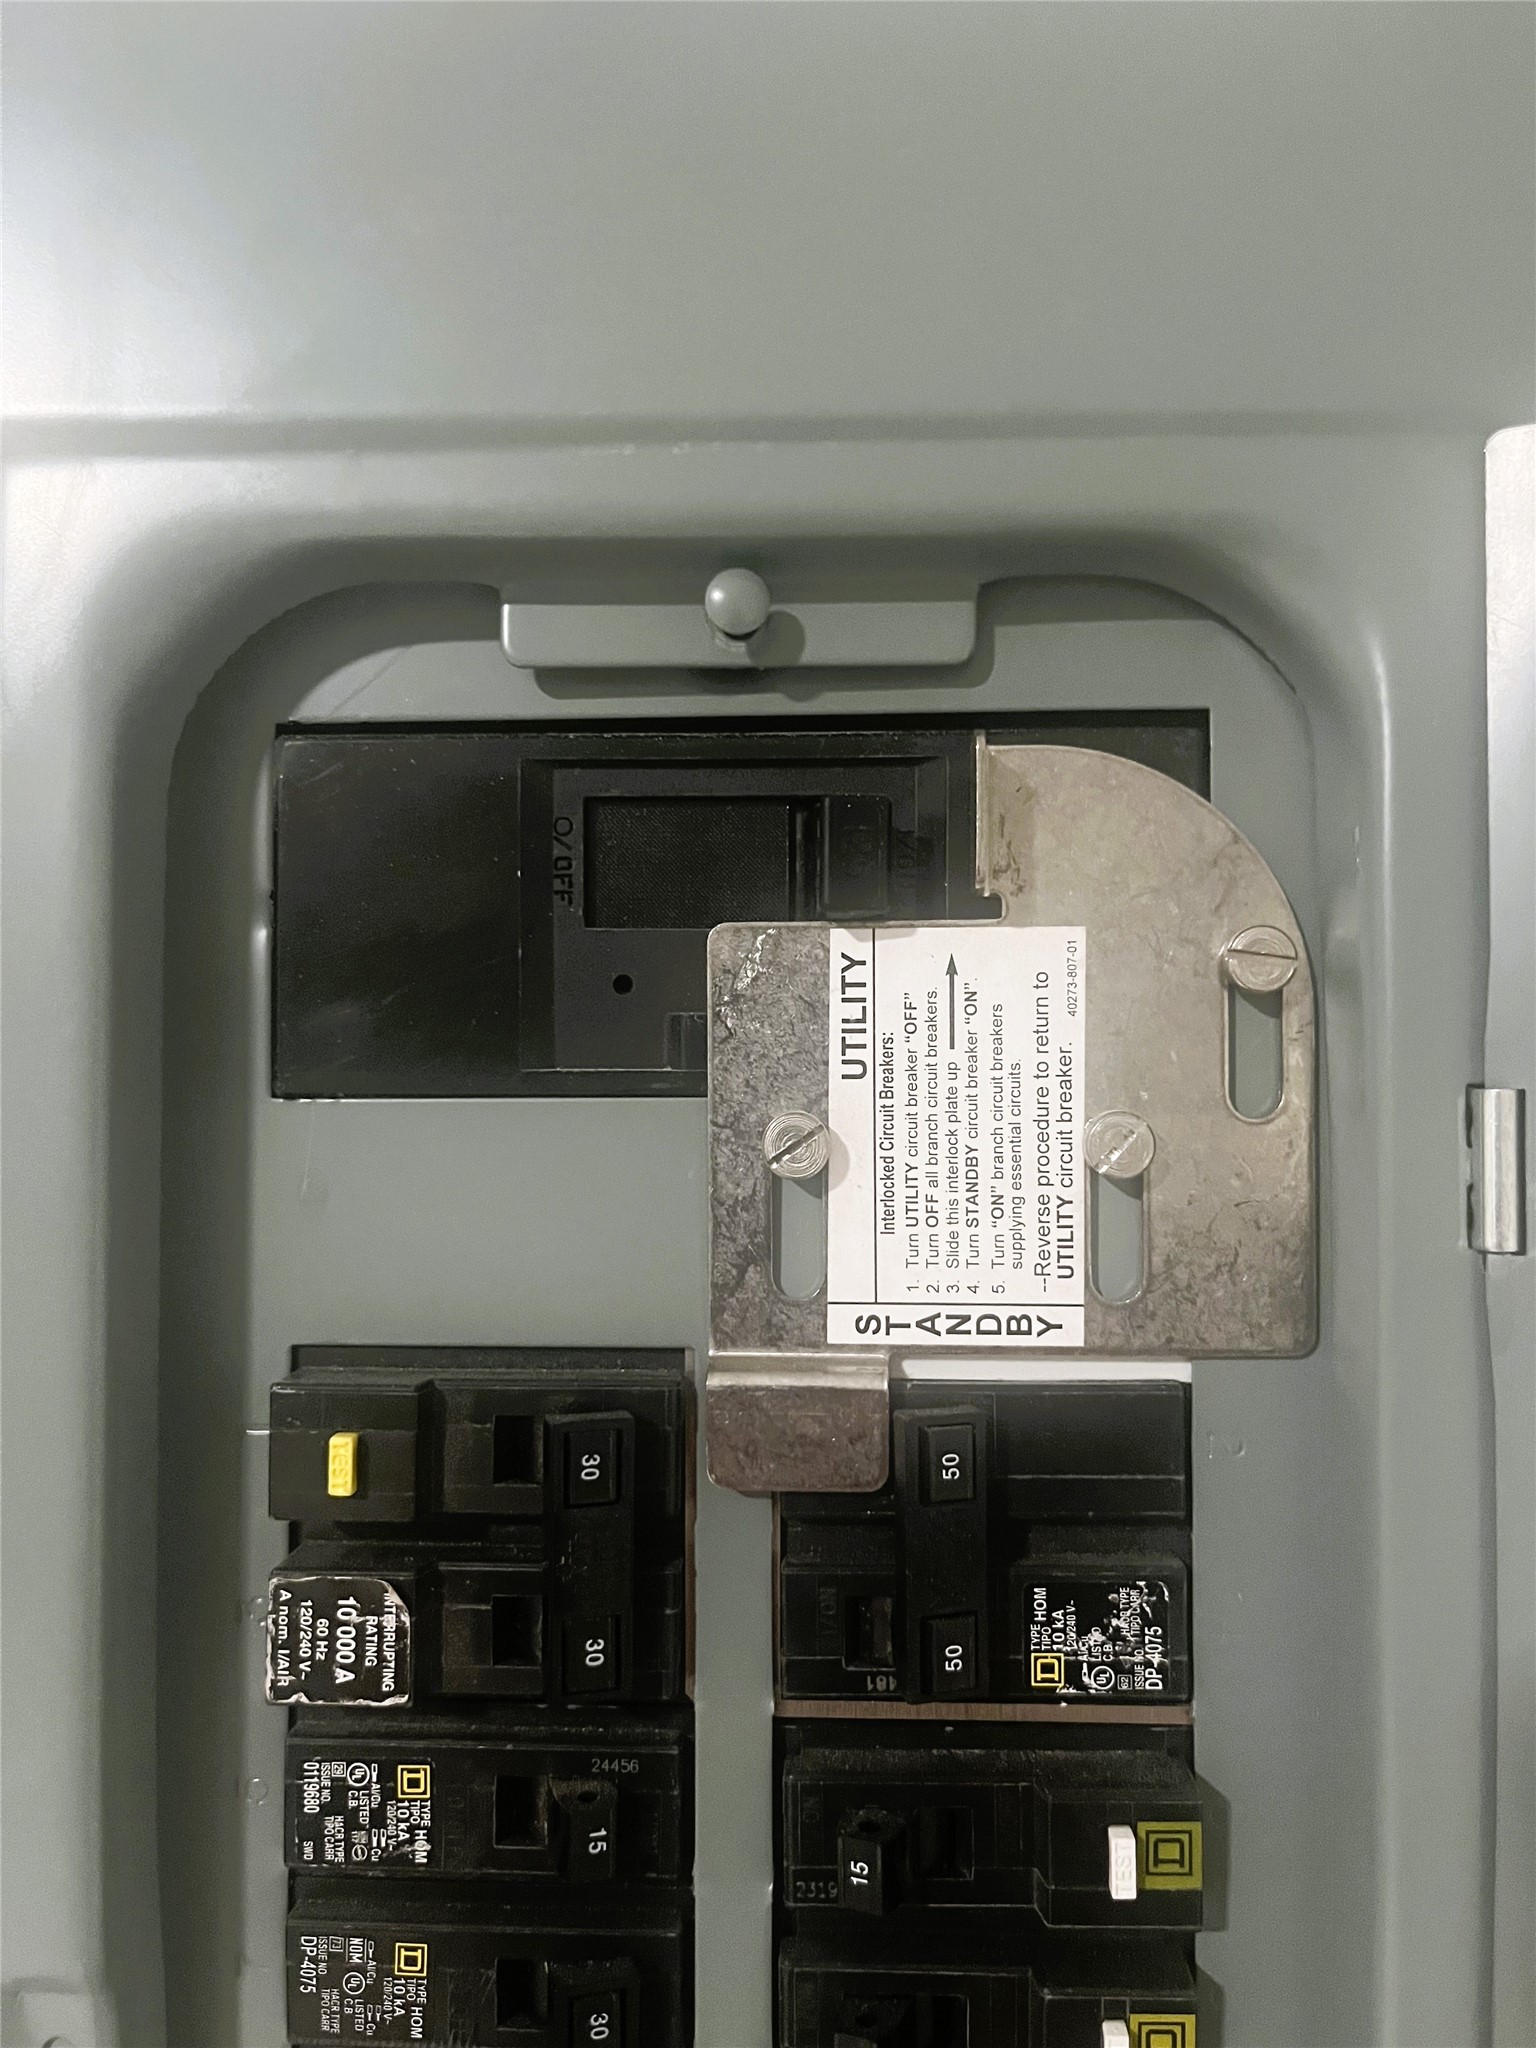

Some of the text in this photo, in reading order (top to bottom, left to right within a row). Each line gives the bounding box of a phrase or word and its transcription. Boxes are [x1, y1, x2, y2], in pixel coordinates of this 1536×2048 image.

[1033, 971, 1048, 990] to
[1067, 940, 1078, 1017] 40273-807-01
[841, 952, 867, 1080] UTILITY
[1034, 996, 1049, 1054] return
[989, 1004, 1004, 1072] breakers
[964, 1030, 978, 1088] breaker
[1035, 1061, 1050, 1079] to
[904, 1048, 919, 1107] breaker
[964, 1094, 978, 1139] circuit
[990, 1077, 1004, 1122] circuit
[879, 1032, 895, 1235] Interlocked Circuit Breakers:
[904, 1112, 919, 1157] circuit
[924, 987, 939, 1293] 2. Turn OFF all branch circuit breakers.
[1033, 1087, 1053, 1186] procedure
[990, 1127, 1004, 1180] branch
[1008, 1059, 1025, 1269] supplying essential circuits.
[1056, 1042, 1074, 1280] UTILITY circuit breaker.
[905, 1162, 919, 1228] UTILITY
[944, 1062, 961, 1293] 3. Slide this interlock plate up
[965, 1144, 979, 1228] STANDBY
[906, 1234, 919, 1268] Turn
[966, 1234, 979, 1269] Turn
[992, 1234, 1005, 1269] Turn
[907, 1280, 919, 1292] 1.
[967, 1280, 979, 1293] 4.
[992, 1281, 1005, 1294] 5.
[332, 1441, 349, 1492] TEST
[580, 1453, 601, 1481] 30
[942, 1453, 959, 1480] 50
[280, 1590, 291, 1601] A
[1120, 1587, 1129, 1609] TYPE
[279, 1606, 290, 1643] nom.
[300, 1599, 312, 1657] 120/240
[1031, 1588, 1046, 1651] TYPE HOM
[1052, 1610, 1064, 1651] 10 kA
[1131, 1615, 1140, 1634] TIPO
[316, 1618, 328, 1660] 60 Hz
[335, 1596, 358, 1683] 10 000 A
[365, 1616, 378, 1666] RATING
[584, 1638, 605, 1667] 30
[1042, 1627, 1051, 1651] TIPO
[1092, 1627, 1101, 1661] LISTD
[946, 1645, 963, 1671] 50
[1121, 1677, 1128, 1688] 62
[1135, 1665, 1144, 1689] ISSUE
[321, 1762, 330, 1787] ISSUE
[334, 1764, 343, 1774] 29
[592, 1759, 639, 1773] 24456
[304, 1762, 319, 1812] 0119680
[348, 1790, 358, 1809] C.B.
[359, 1790, 369, 1824] LISTED
[387, 1800, 396, 1835] 120/240
[398, 1801, 410, 1840] 10 kA
[410, 1800, 420, 1823] TIPO
[324, 1816, 334, 1860] TIPO CARR
[334, 1816, 344, 1862] HACR TYPE
[415, 1800, 430, 1862] TYPE HOM
[589, 1828, 607, 1854] 15
[304, 1841, 313, 1860] SWD
[371, 1848, 380, 1861] Cu
[850, 1860, 869, 1885] 15
[1116, 1842, 1132, 1896] TEST
[300, 1936, 316, 1993] DP-4075
[318, 1936, 327, 1960] ISSUE
[349, 1938, 363, 1962] NOM
[384, 1977, 392, 2011] 120/240
[393, 1978, 405, 2016] 10 kA
[407, 1979, 416, 2000] TIPO
[322, 1989, 330, 2030] TIPO CARR
[331, 1989, 339, 2033] HACR TYPE
[355, 1999, 364, 2031] LISTED
[410, 1979, 426, 2038] TYPE HOM
[590, 2013, 609, 2040] 30
[367, 2023, 375, 2035] Cu
